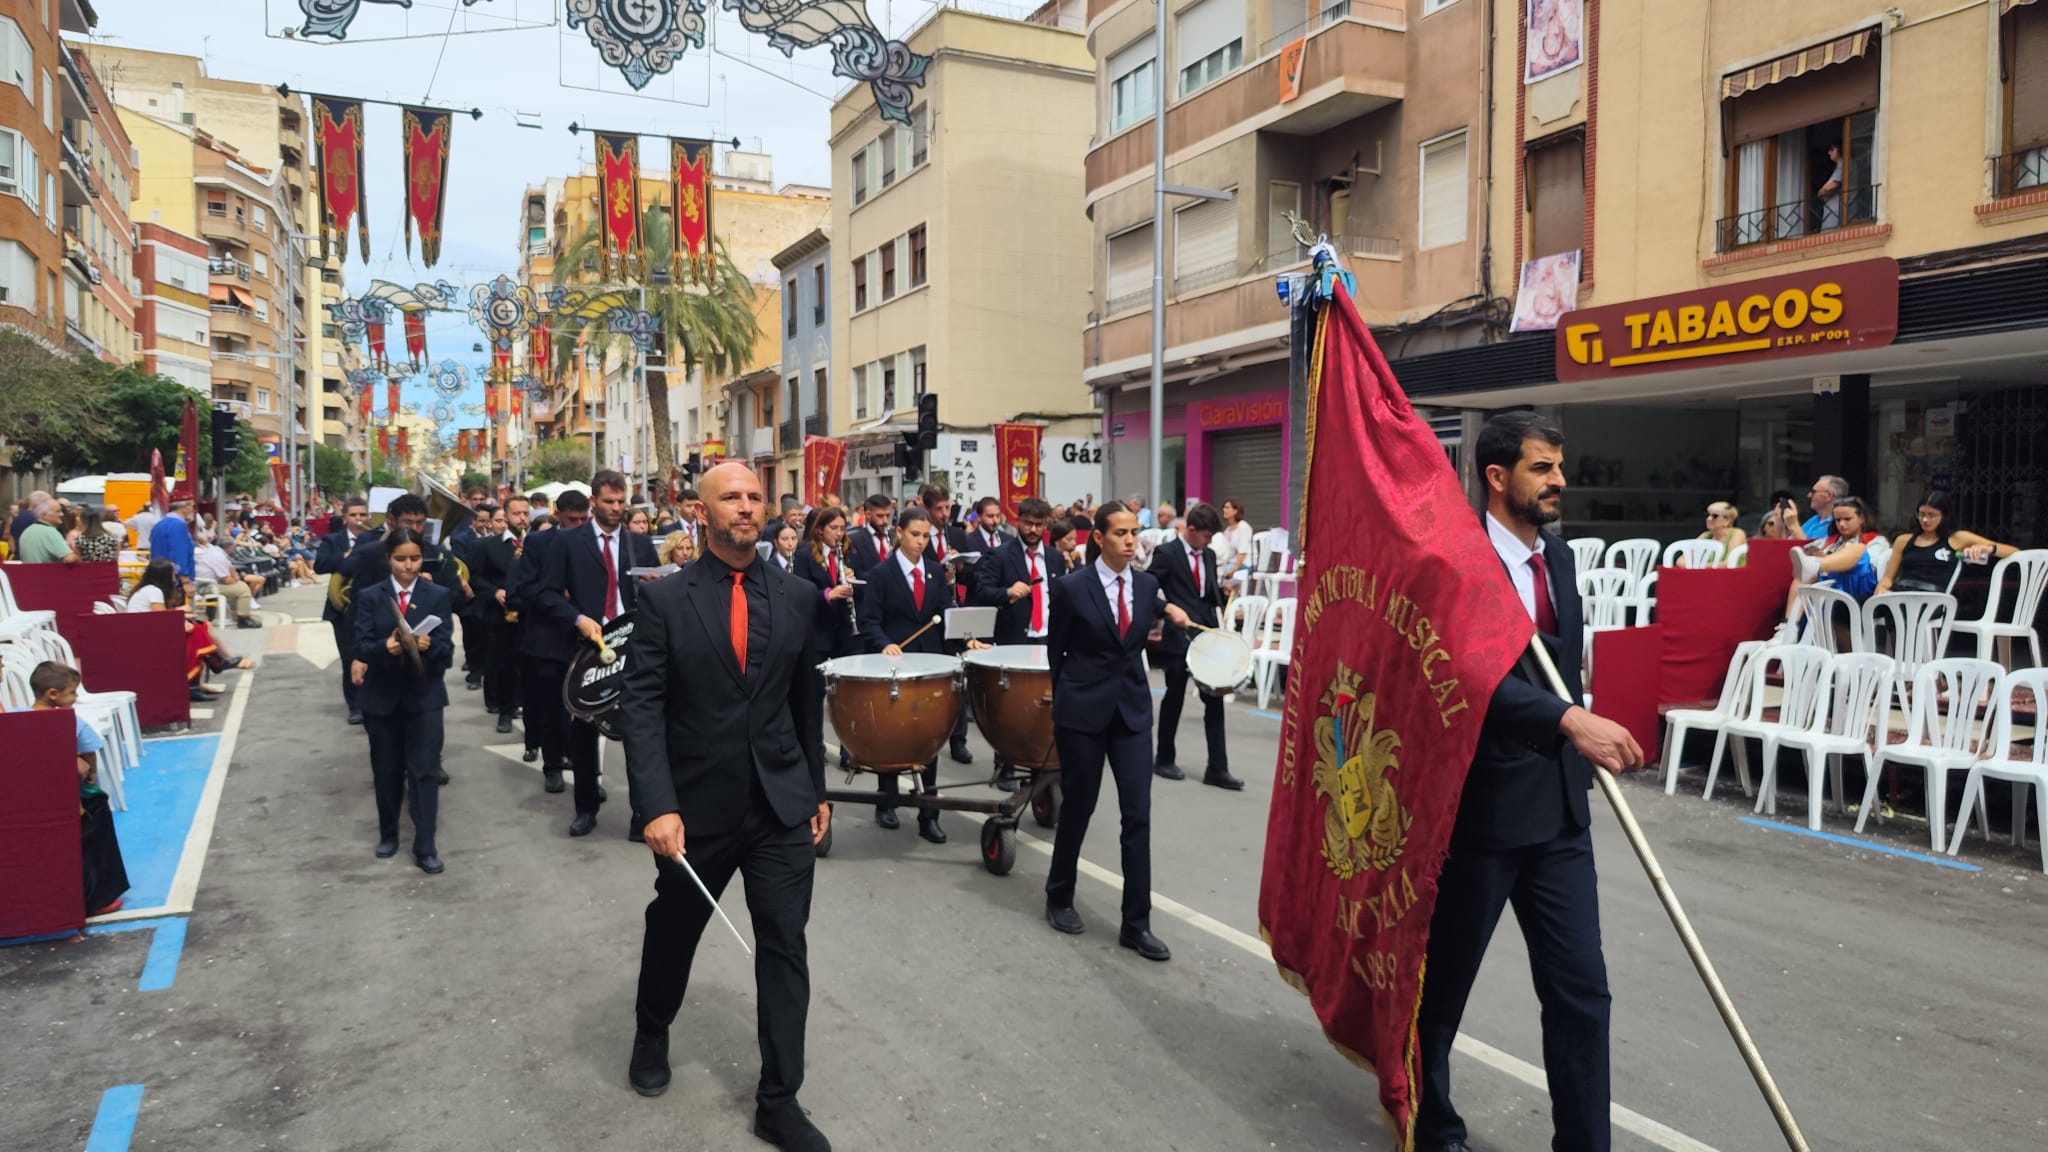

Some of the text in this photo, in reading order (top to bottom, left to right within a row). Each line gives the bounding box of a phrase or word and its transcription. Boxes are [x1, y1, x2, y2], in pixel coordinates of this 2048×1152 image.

[1624, 282, 1843, 349] TABACOS
[1776, 334, 1807, 347] EXP.
[1383, 588, 1469, 728] MUSICAL
